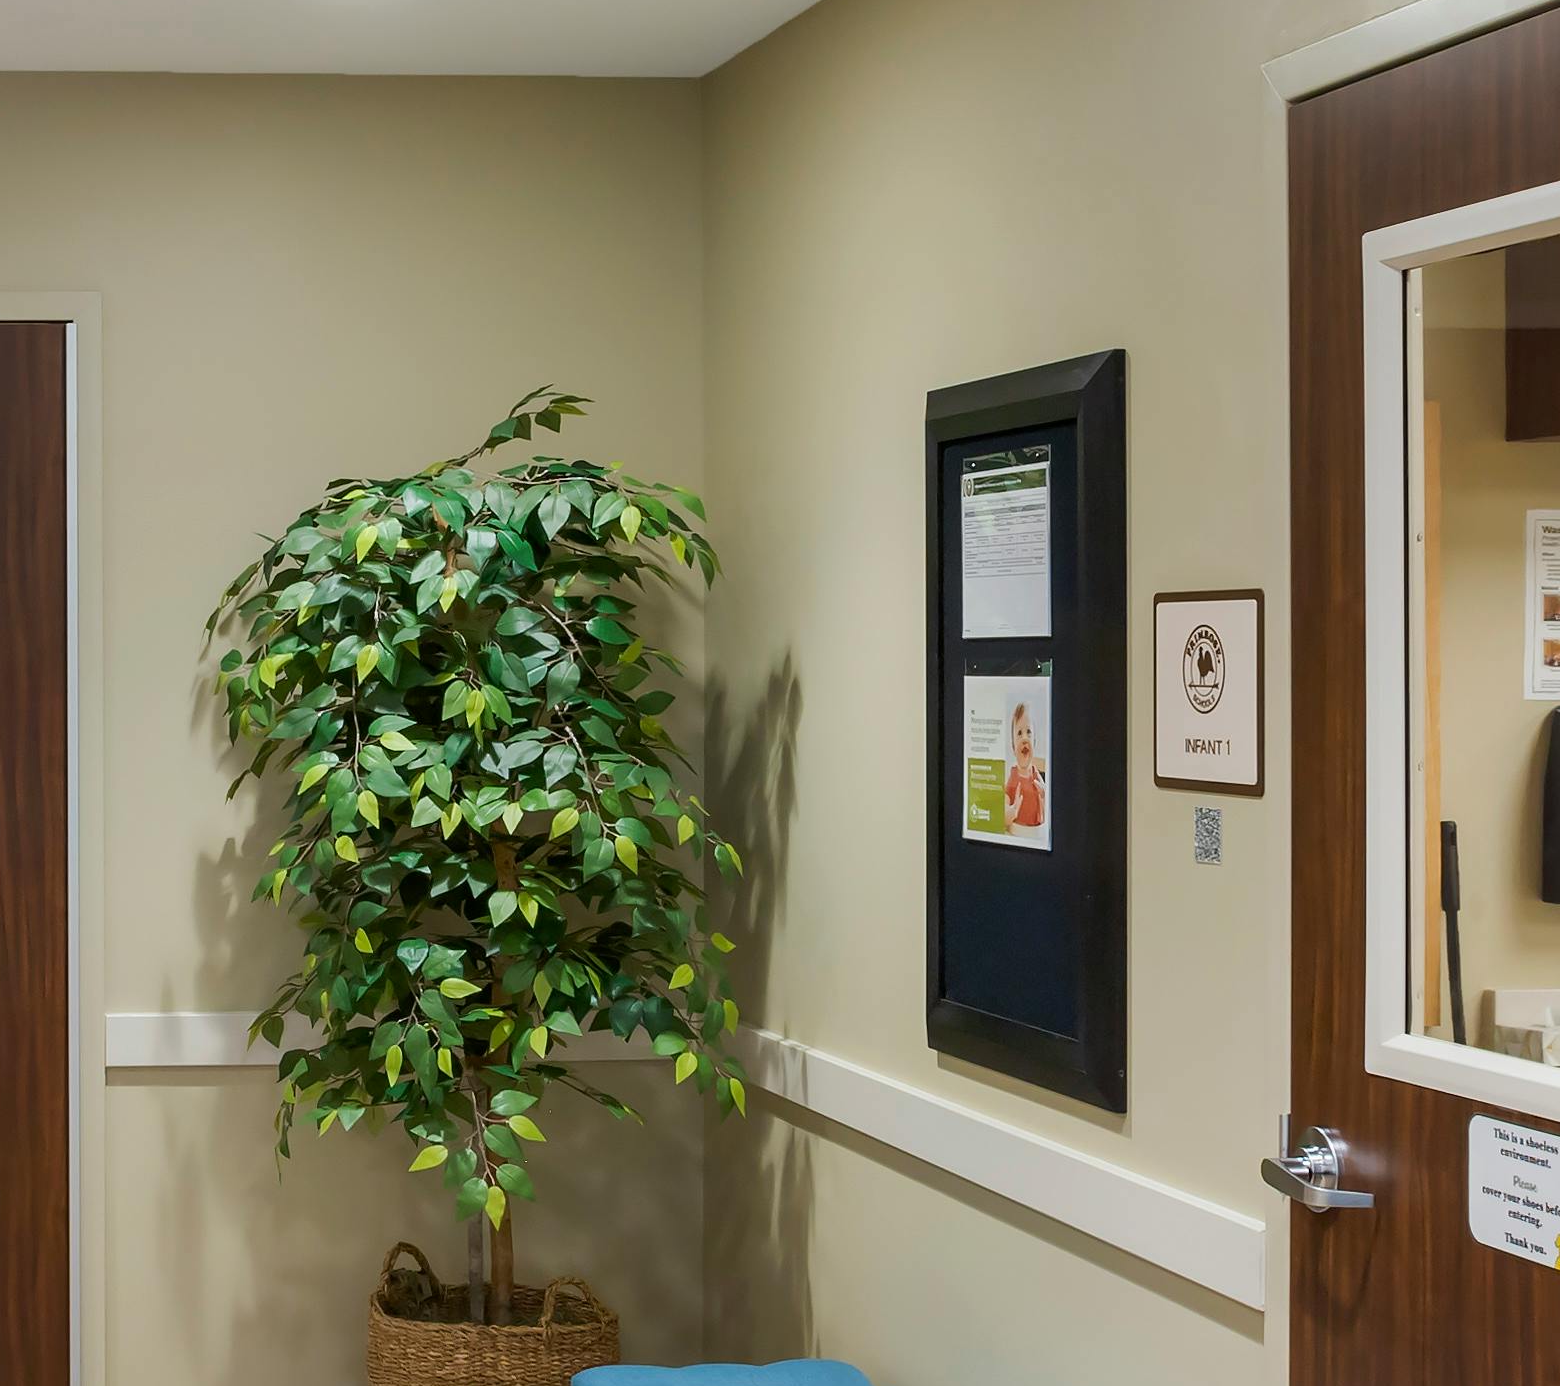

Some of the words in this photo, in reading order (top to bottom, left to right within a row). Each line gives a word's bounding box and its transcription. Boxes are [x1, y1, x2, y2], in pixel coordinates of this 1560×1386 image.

[1186, 629, 1221, 658] PRIMROSE
[1185, 738, 1223, 755] INFANT
[1226, 740, 1231, 756] 1
[1493, 1127, 1510, 1143] This
[1511, 1131, 1519, 1144] is
[1519, 1137, 1525, 1146] a
[1526, 1136, 1559, 1155] shoeless
[1500, 1147, 1552, 1169] environment.
[1482, 1184, 1502, 1199] cover
[1503, 1191, 1521, 1205] your
[1522, 1195, 1544, 1212] shoes
[1507, 1209, 1543, 1229] entering.
[1504, 1232, 1529, 1249] Thank
[1530, 1240, 1548, 1256] you.
